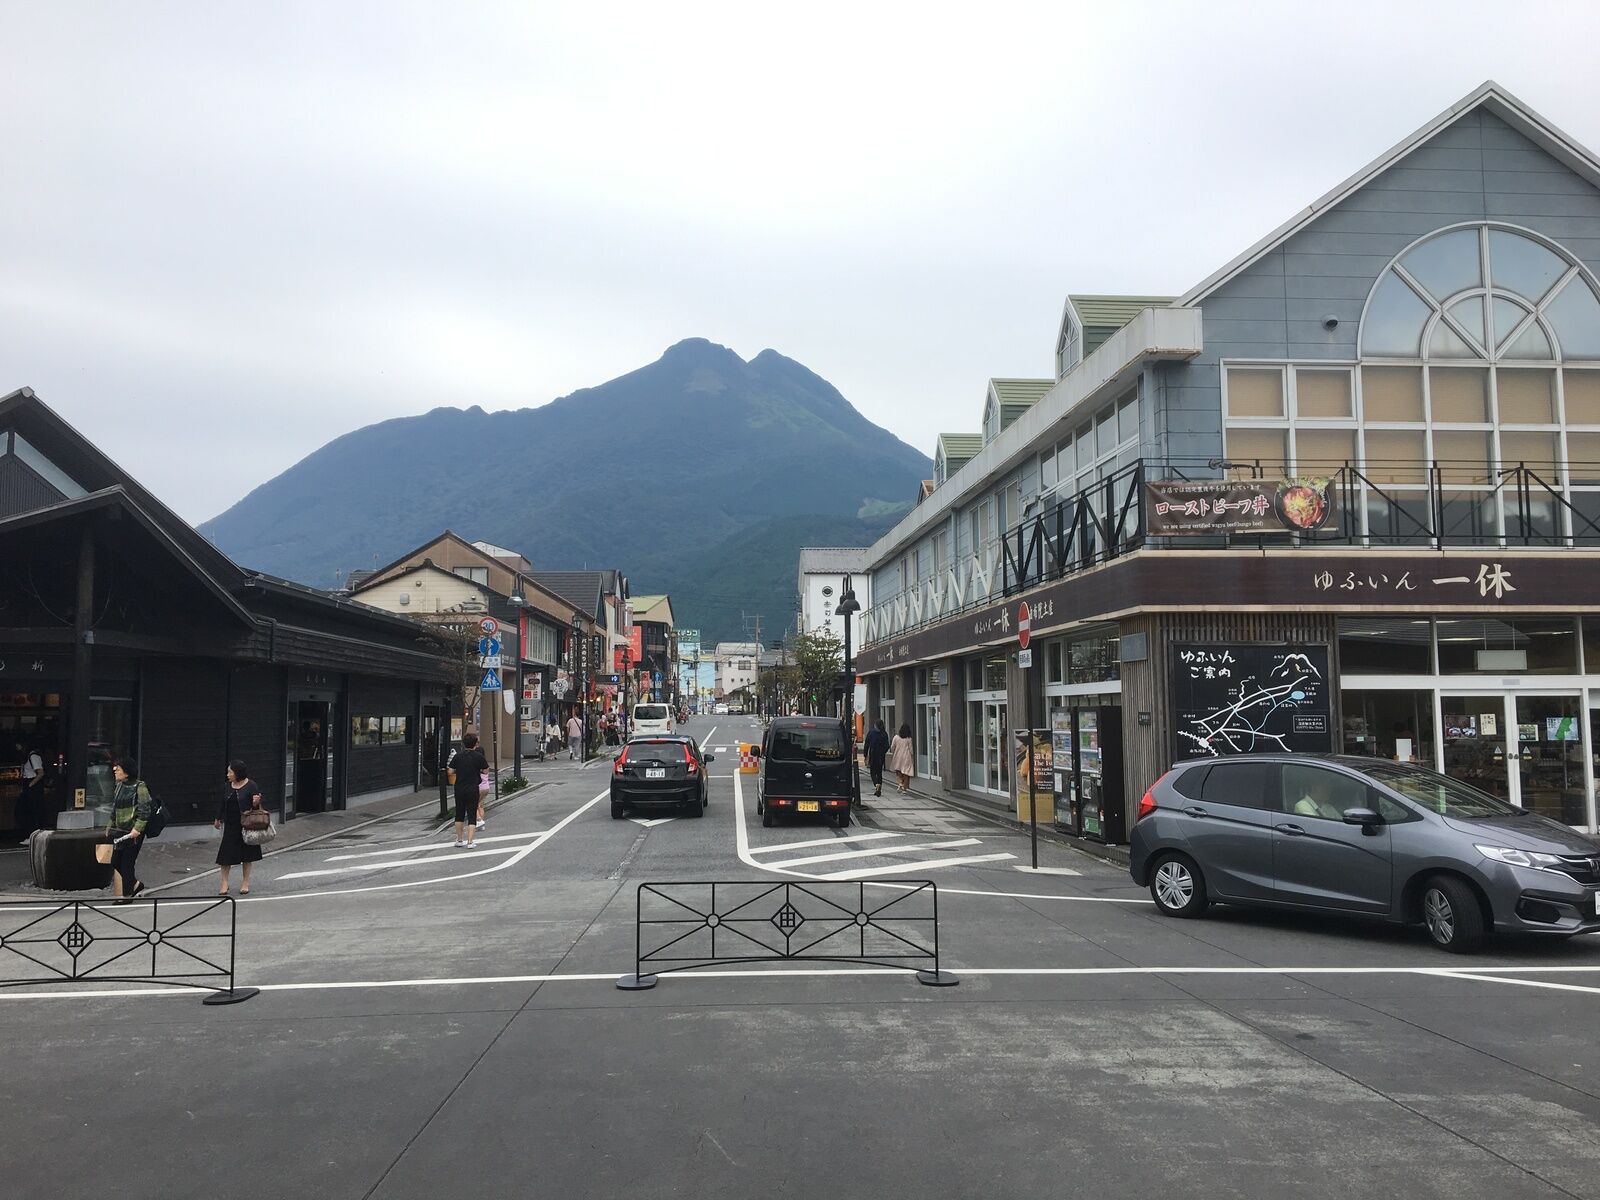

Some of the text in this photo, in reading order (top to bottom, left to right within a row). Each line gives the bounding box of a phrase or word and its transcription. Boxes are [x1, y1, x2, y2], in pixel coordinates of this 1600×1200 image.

[1314, 563, 1517, 599] ゆふいん 一休
[993, 607, 1010, 632] 一休
[1180, 650, 1236, 664] ゆふいん
[1190, 665, 1231, 679] ご案内
